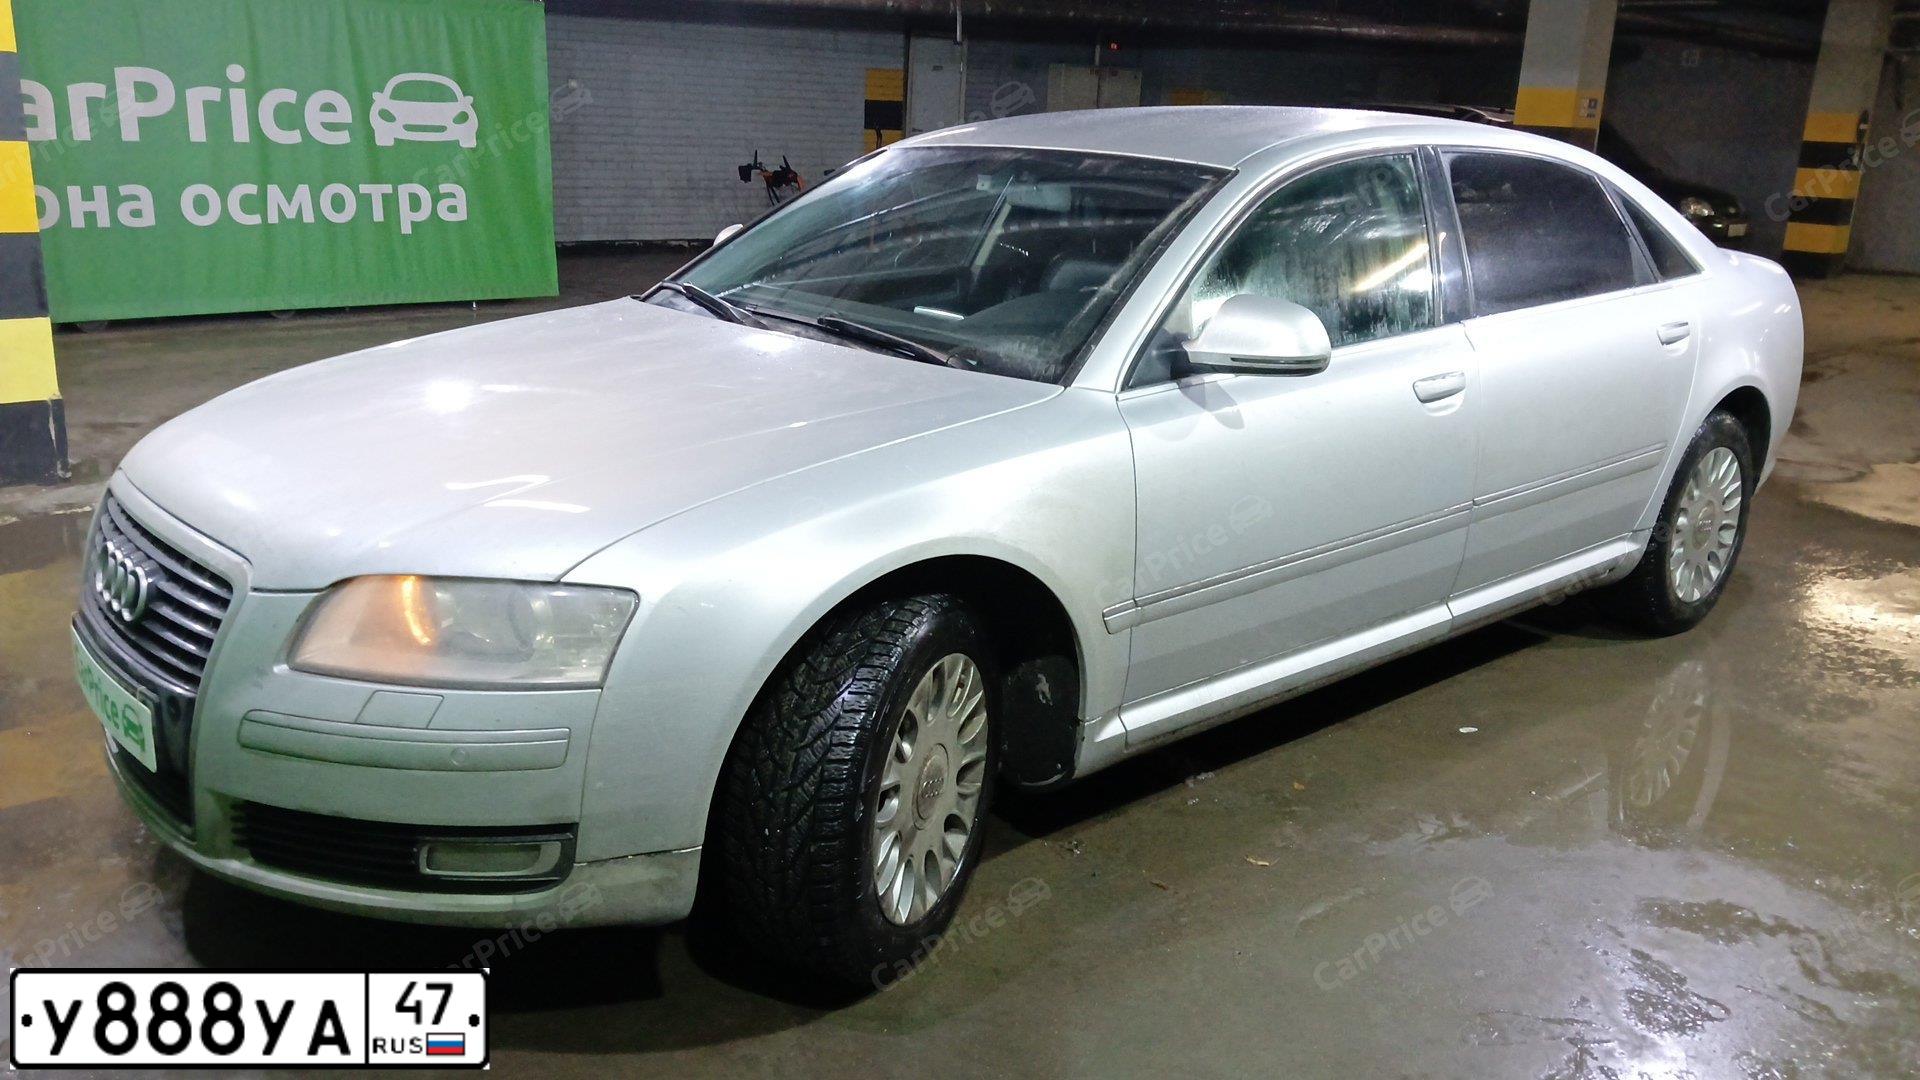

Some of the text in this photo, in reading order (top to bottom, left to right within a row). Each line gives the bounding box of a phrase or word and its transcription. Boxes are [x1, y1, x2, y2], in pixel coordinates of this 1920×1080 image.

[20, 64, 353, 145] arPrice
[33, 183, 468, 235] она осмотра
